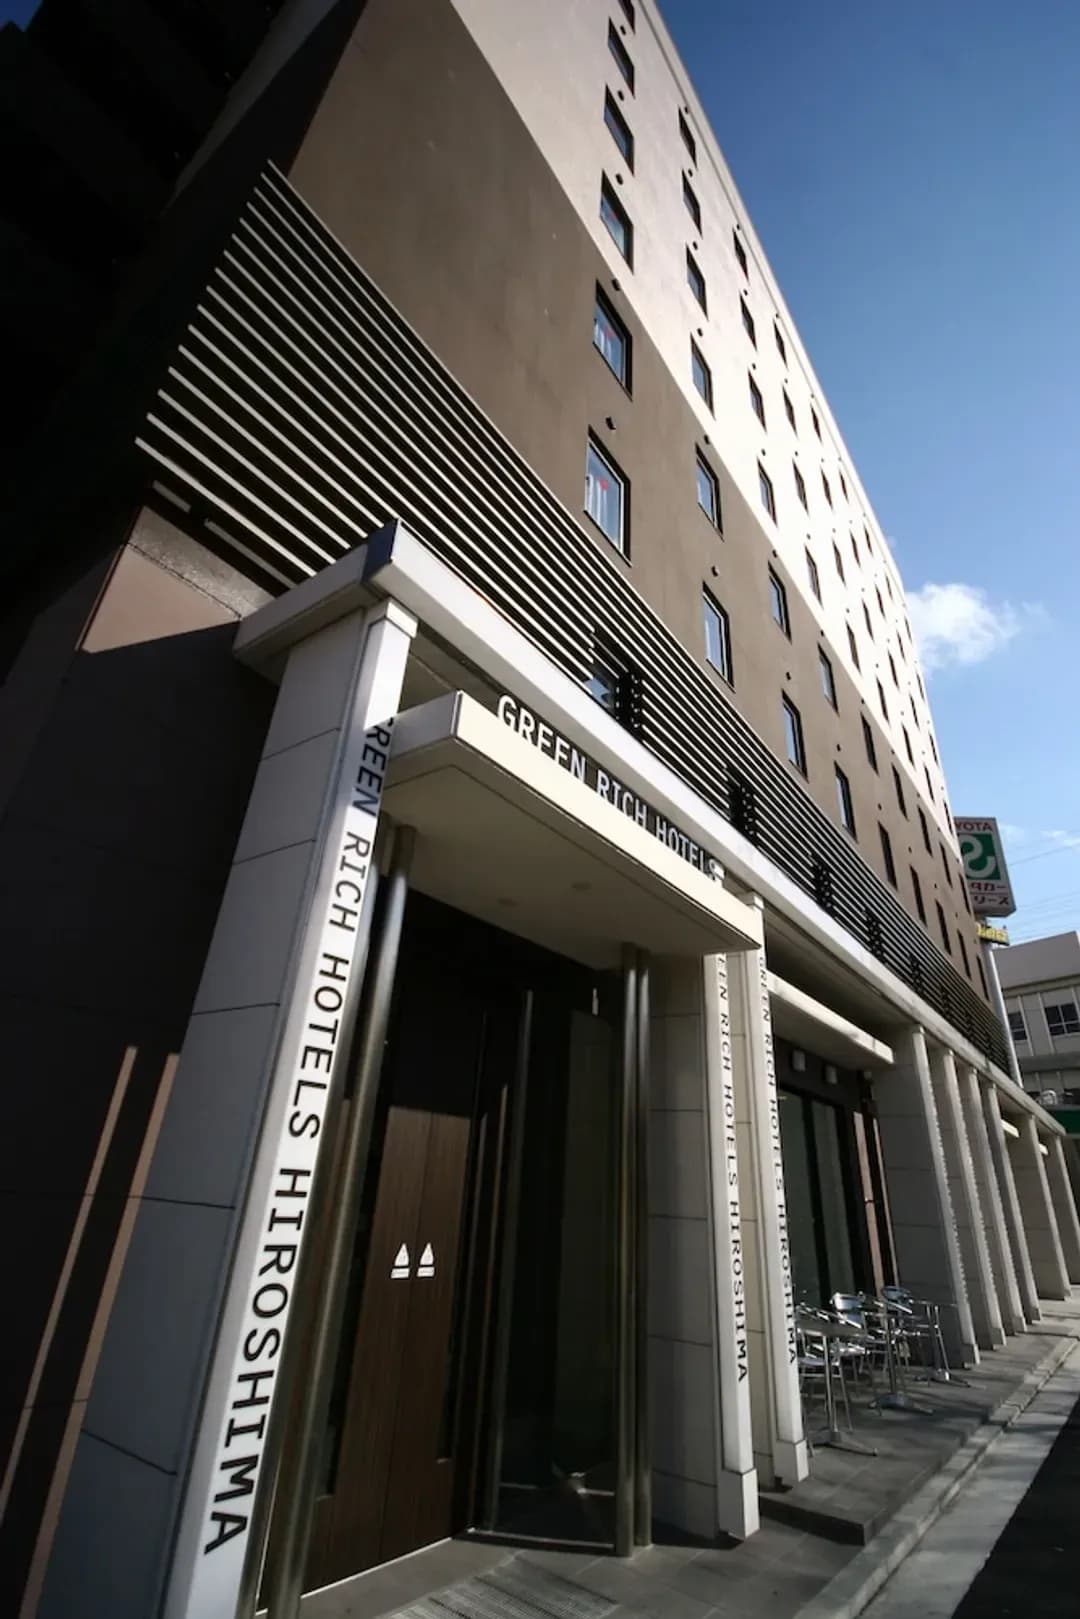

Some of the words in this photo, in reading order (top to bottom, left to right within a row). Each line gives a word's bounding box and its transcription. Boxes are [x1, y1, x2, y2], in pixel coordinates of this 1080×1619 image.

[352, 717, 394, 818] REEN
[498, 694, 586, 784] GREEN
[596, 768, 648, 831] RICH
[655, 815, 726, 882] HOTELS
[955, 821, 993, 832] YOTA
[329, 831, 371, 932] RICH
[970, 882, 1007, 892] タカー
[288, 953, 350, 1139] HOTELS
[720, 1013, 730, 1071] RICH
[724, 1085, 736, 1186] HOTELS
[730, 1201, 748, 1382] HIROSHIMA
[777, 1204, 797, 1364] HIROSHIMA
[204, 1168, 312, 1555] HIROSHIMA
